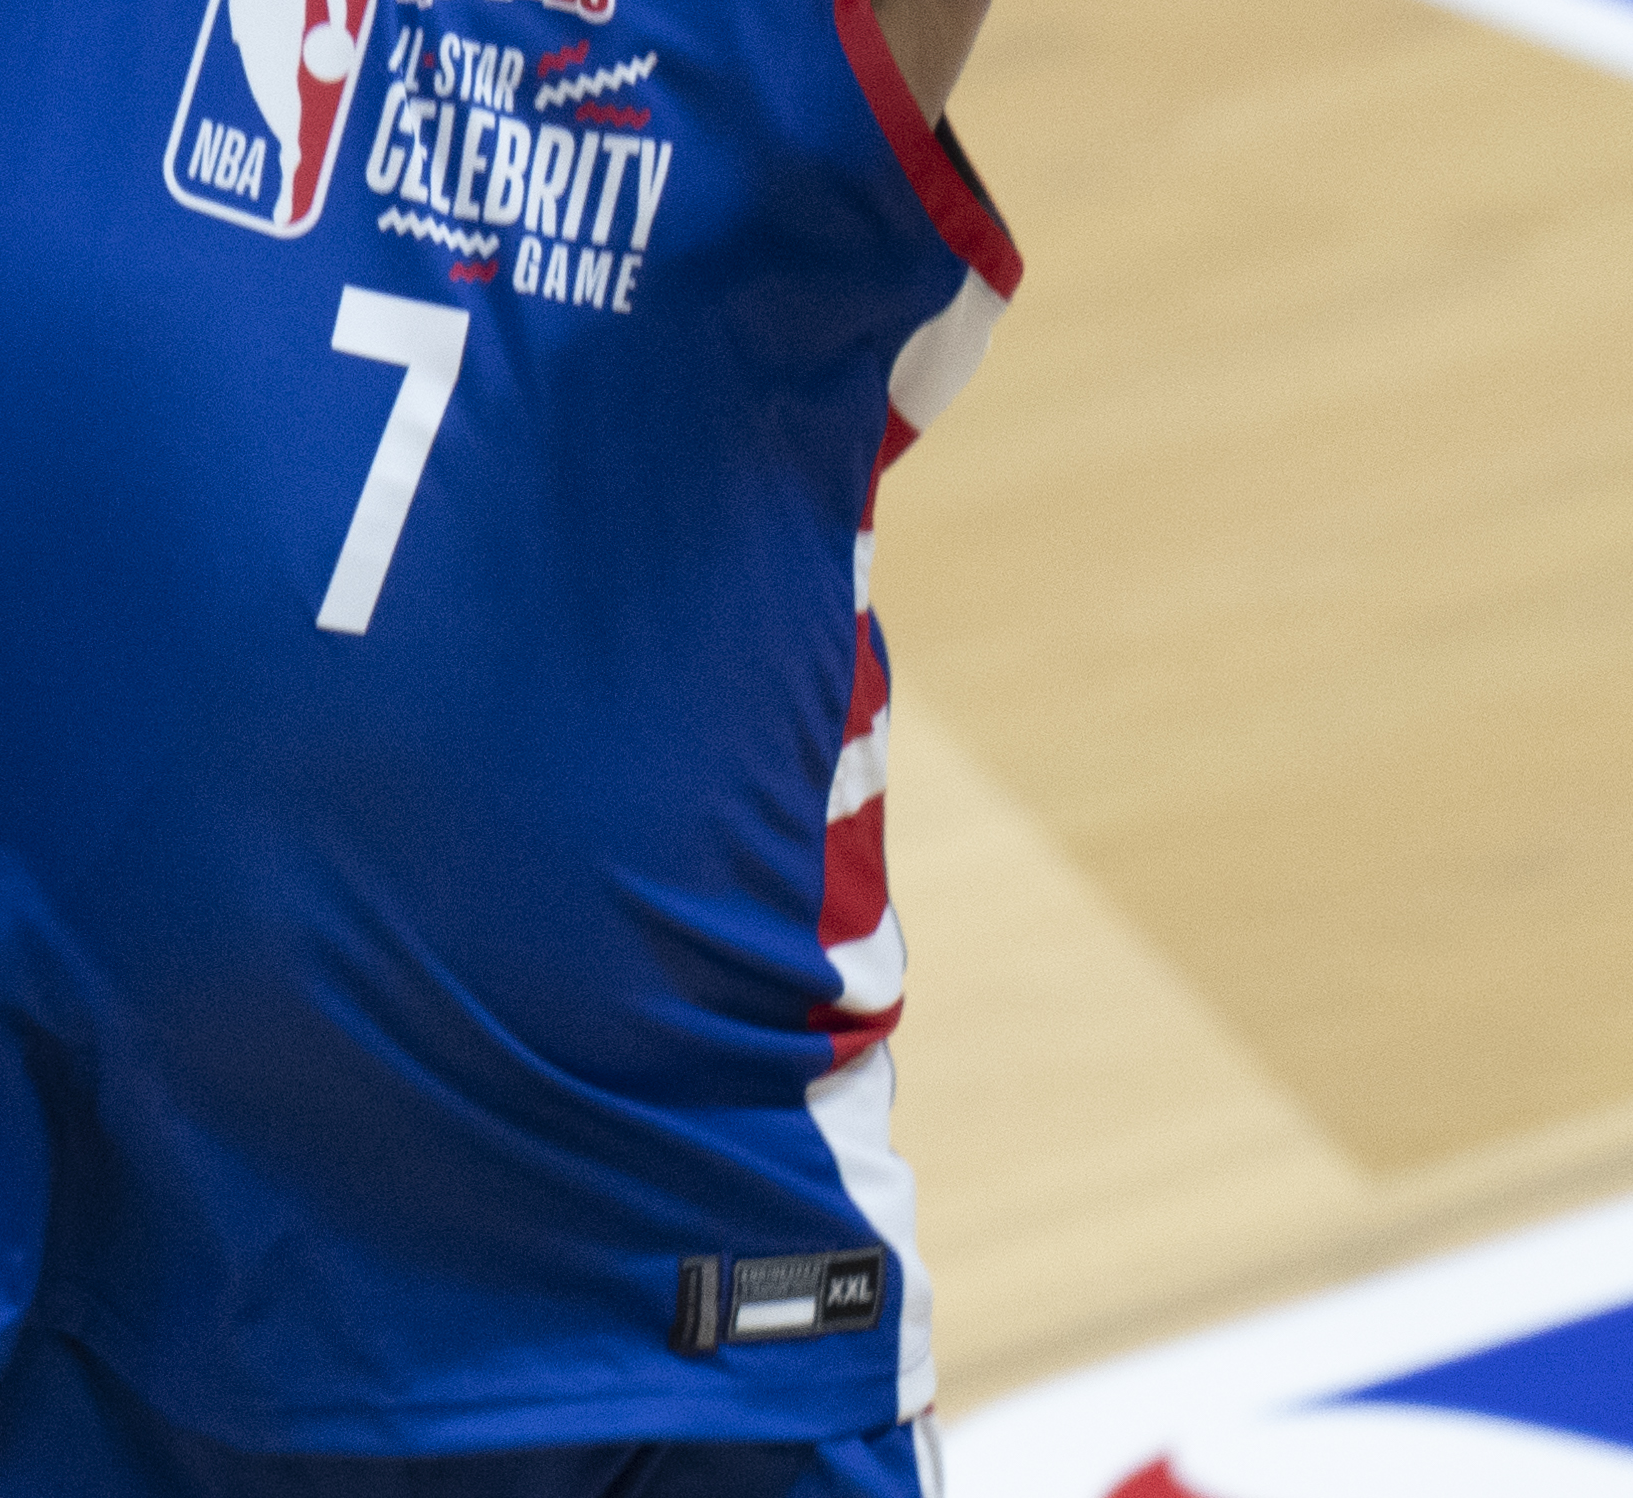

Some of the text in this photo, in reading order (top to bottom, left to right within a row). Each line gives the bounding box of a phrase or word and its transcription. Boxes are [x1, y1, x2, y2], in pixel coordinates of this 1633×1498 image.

[188, 118, 267, 201] NBA
[365, 80, 672, 252] CELEBRITY
[512, 235, 644, 314] GAME
[315, 283, 471, 637] 7
[827, 1272, 874, 1307] XXL
